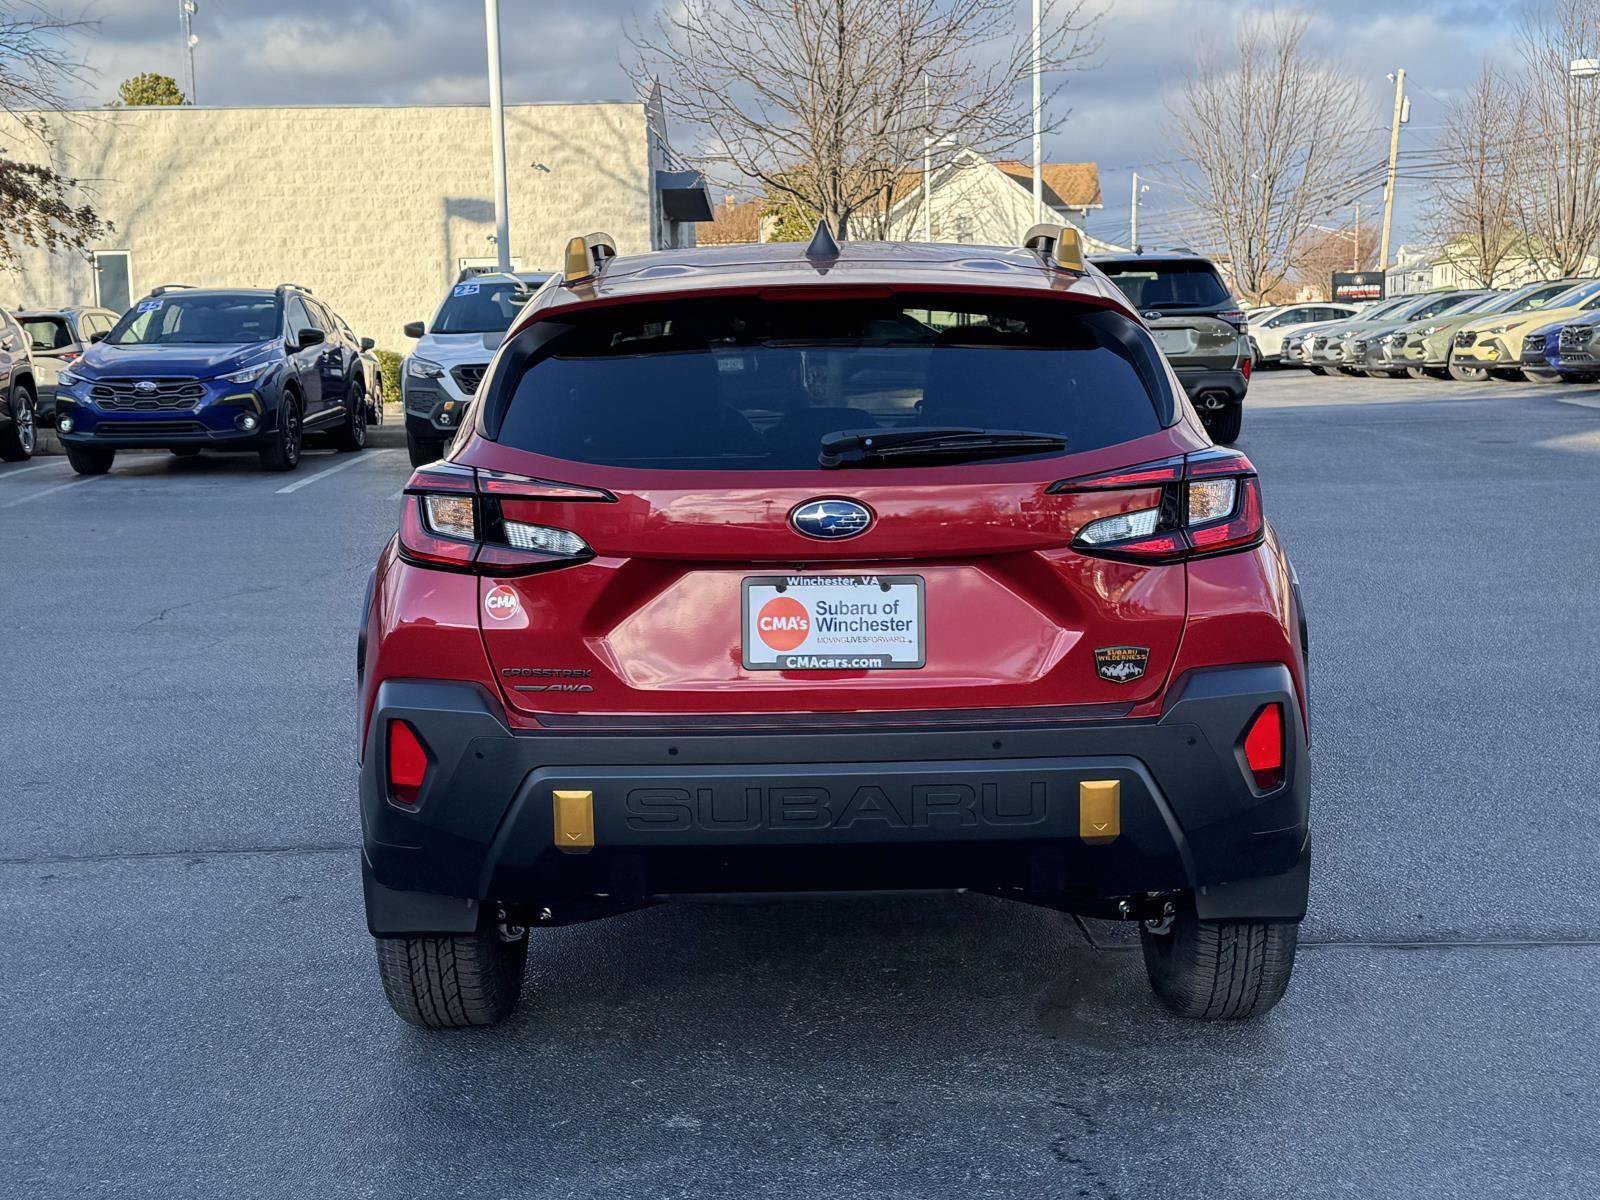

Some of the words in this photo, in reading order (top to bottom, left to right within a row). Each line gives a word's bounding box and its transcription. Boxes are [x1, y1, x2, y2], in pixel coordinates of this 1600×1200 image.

[455, 285, 479, 296] 25
[786, 576, 858, 588] Winchester,
[862, 576, 880, 586] VA
[487, 596, 517, 609] CMA
[816, 601, 877, 616] Subaru
[882, 600, 900, 615] of
[760, 616, 808, 631] CMA's
[816, 617, 913, 632] Winchester
[786, 656, 882, 669] CMAcars.com
[501, 668, 592, 678] CROSSTREK
[546, 684, 594, 692] AWD
[625, 781, 1048, 832] SUBARU
